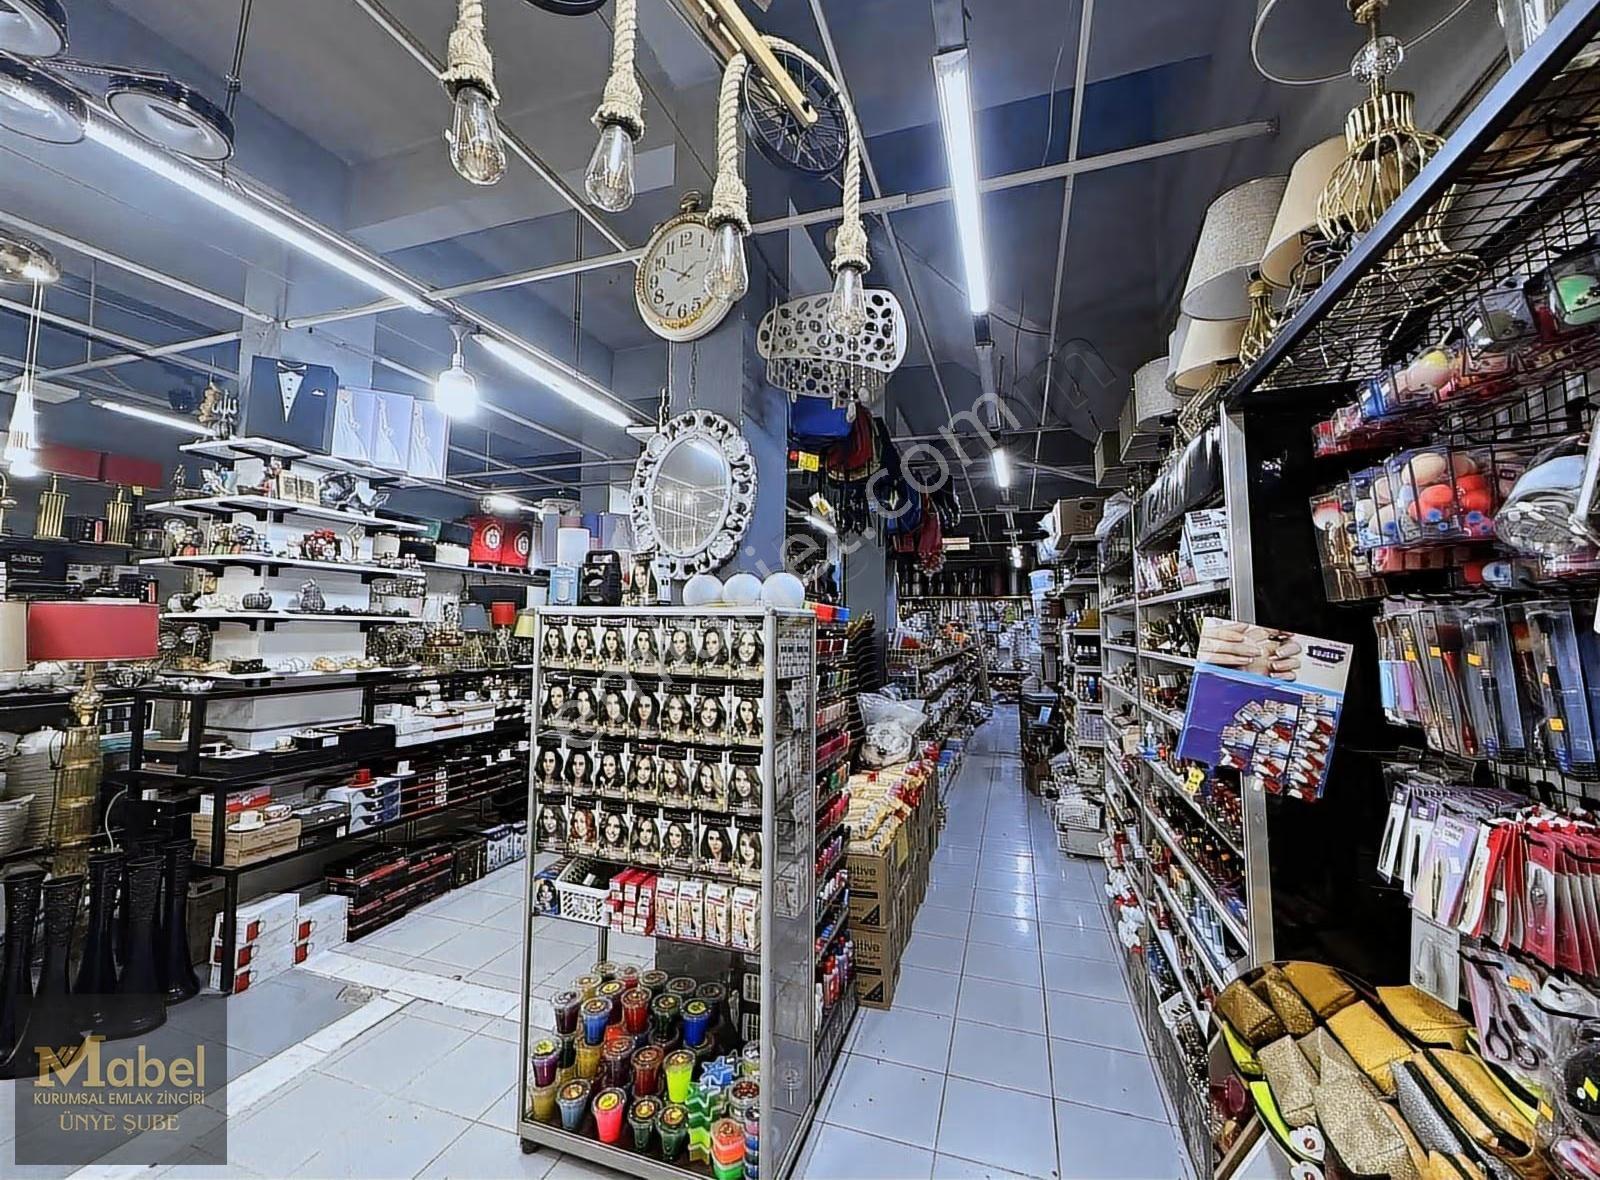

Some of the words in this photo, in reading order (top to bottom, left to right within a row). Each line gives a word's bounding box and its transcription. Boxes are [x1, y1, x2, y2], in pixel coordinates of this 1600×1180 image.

[680, 231, 693, 248] 12
[700, 234, 705, 248] 1
[666, 240, 675, 256] 11
[655, 256, 666, 272] 10
[649, 275, 659, 289] 9
[654, 288, 664, 304] 8
[665, 301, 675, 317] 7
[678, 303, 687, 319] 6
[691, 297, 702, 313] 5
